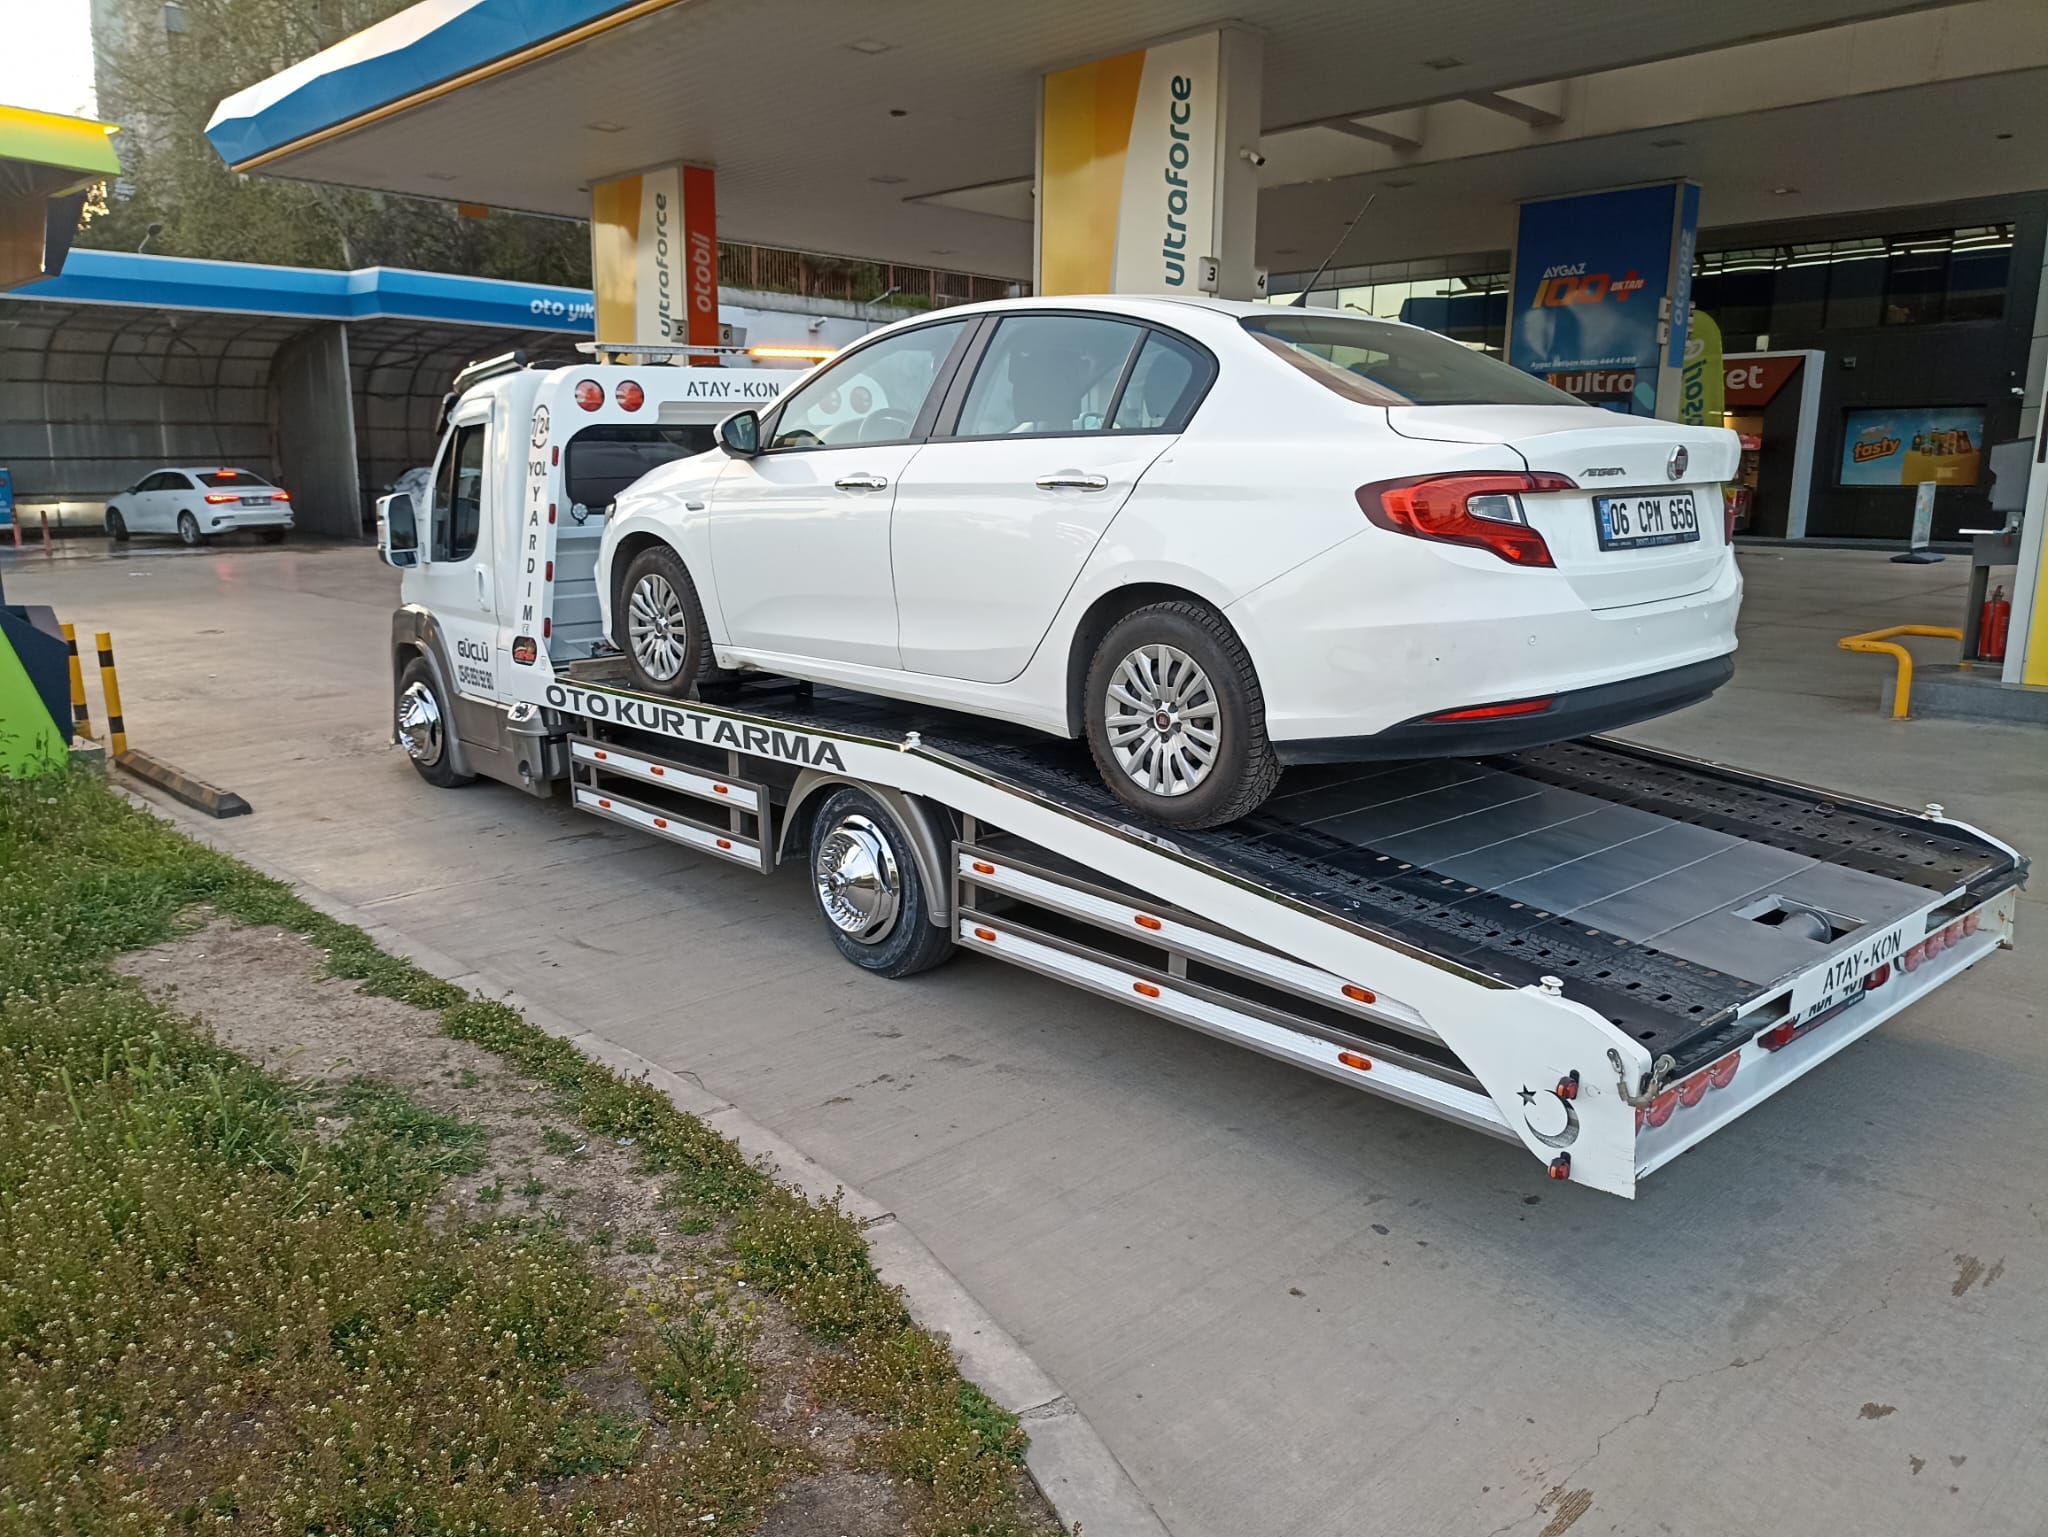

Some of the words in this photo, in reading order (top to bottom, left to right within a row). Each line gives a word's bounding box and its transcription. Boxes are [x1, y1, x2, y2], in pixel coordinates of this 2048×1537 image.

[1162, 75, 1192, 287] ultraforce
[656, 192, 671, 337] ultraforce
[691, 232, 712, 313] otobil
[1543, 263, 1587, 278] AYGAZ
[1207, 266, 1216, 282] 3
[1257, 274, 1266, 289] 4
[530, 299, 565, 316] oto
[675, 325, 684, 336] 5
[722, 329, 730, 340] 6
[687, 381, 780, 398] ATAY-KON
[531, 415, 550, 437] 7/24
[528, 461, 547, 477] YOL
[1611, 502, 1629, 535] 06
[1637, 500, 1664, 533] CPM
[1669, 498, 1693, 530] 656
[457, 638, 489, 664] GÜÇLÜ
[1822, 928, 1902, 995] ATAY-KON
